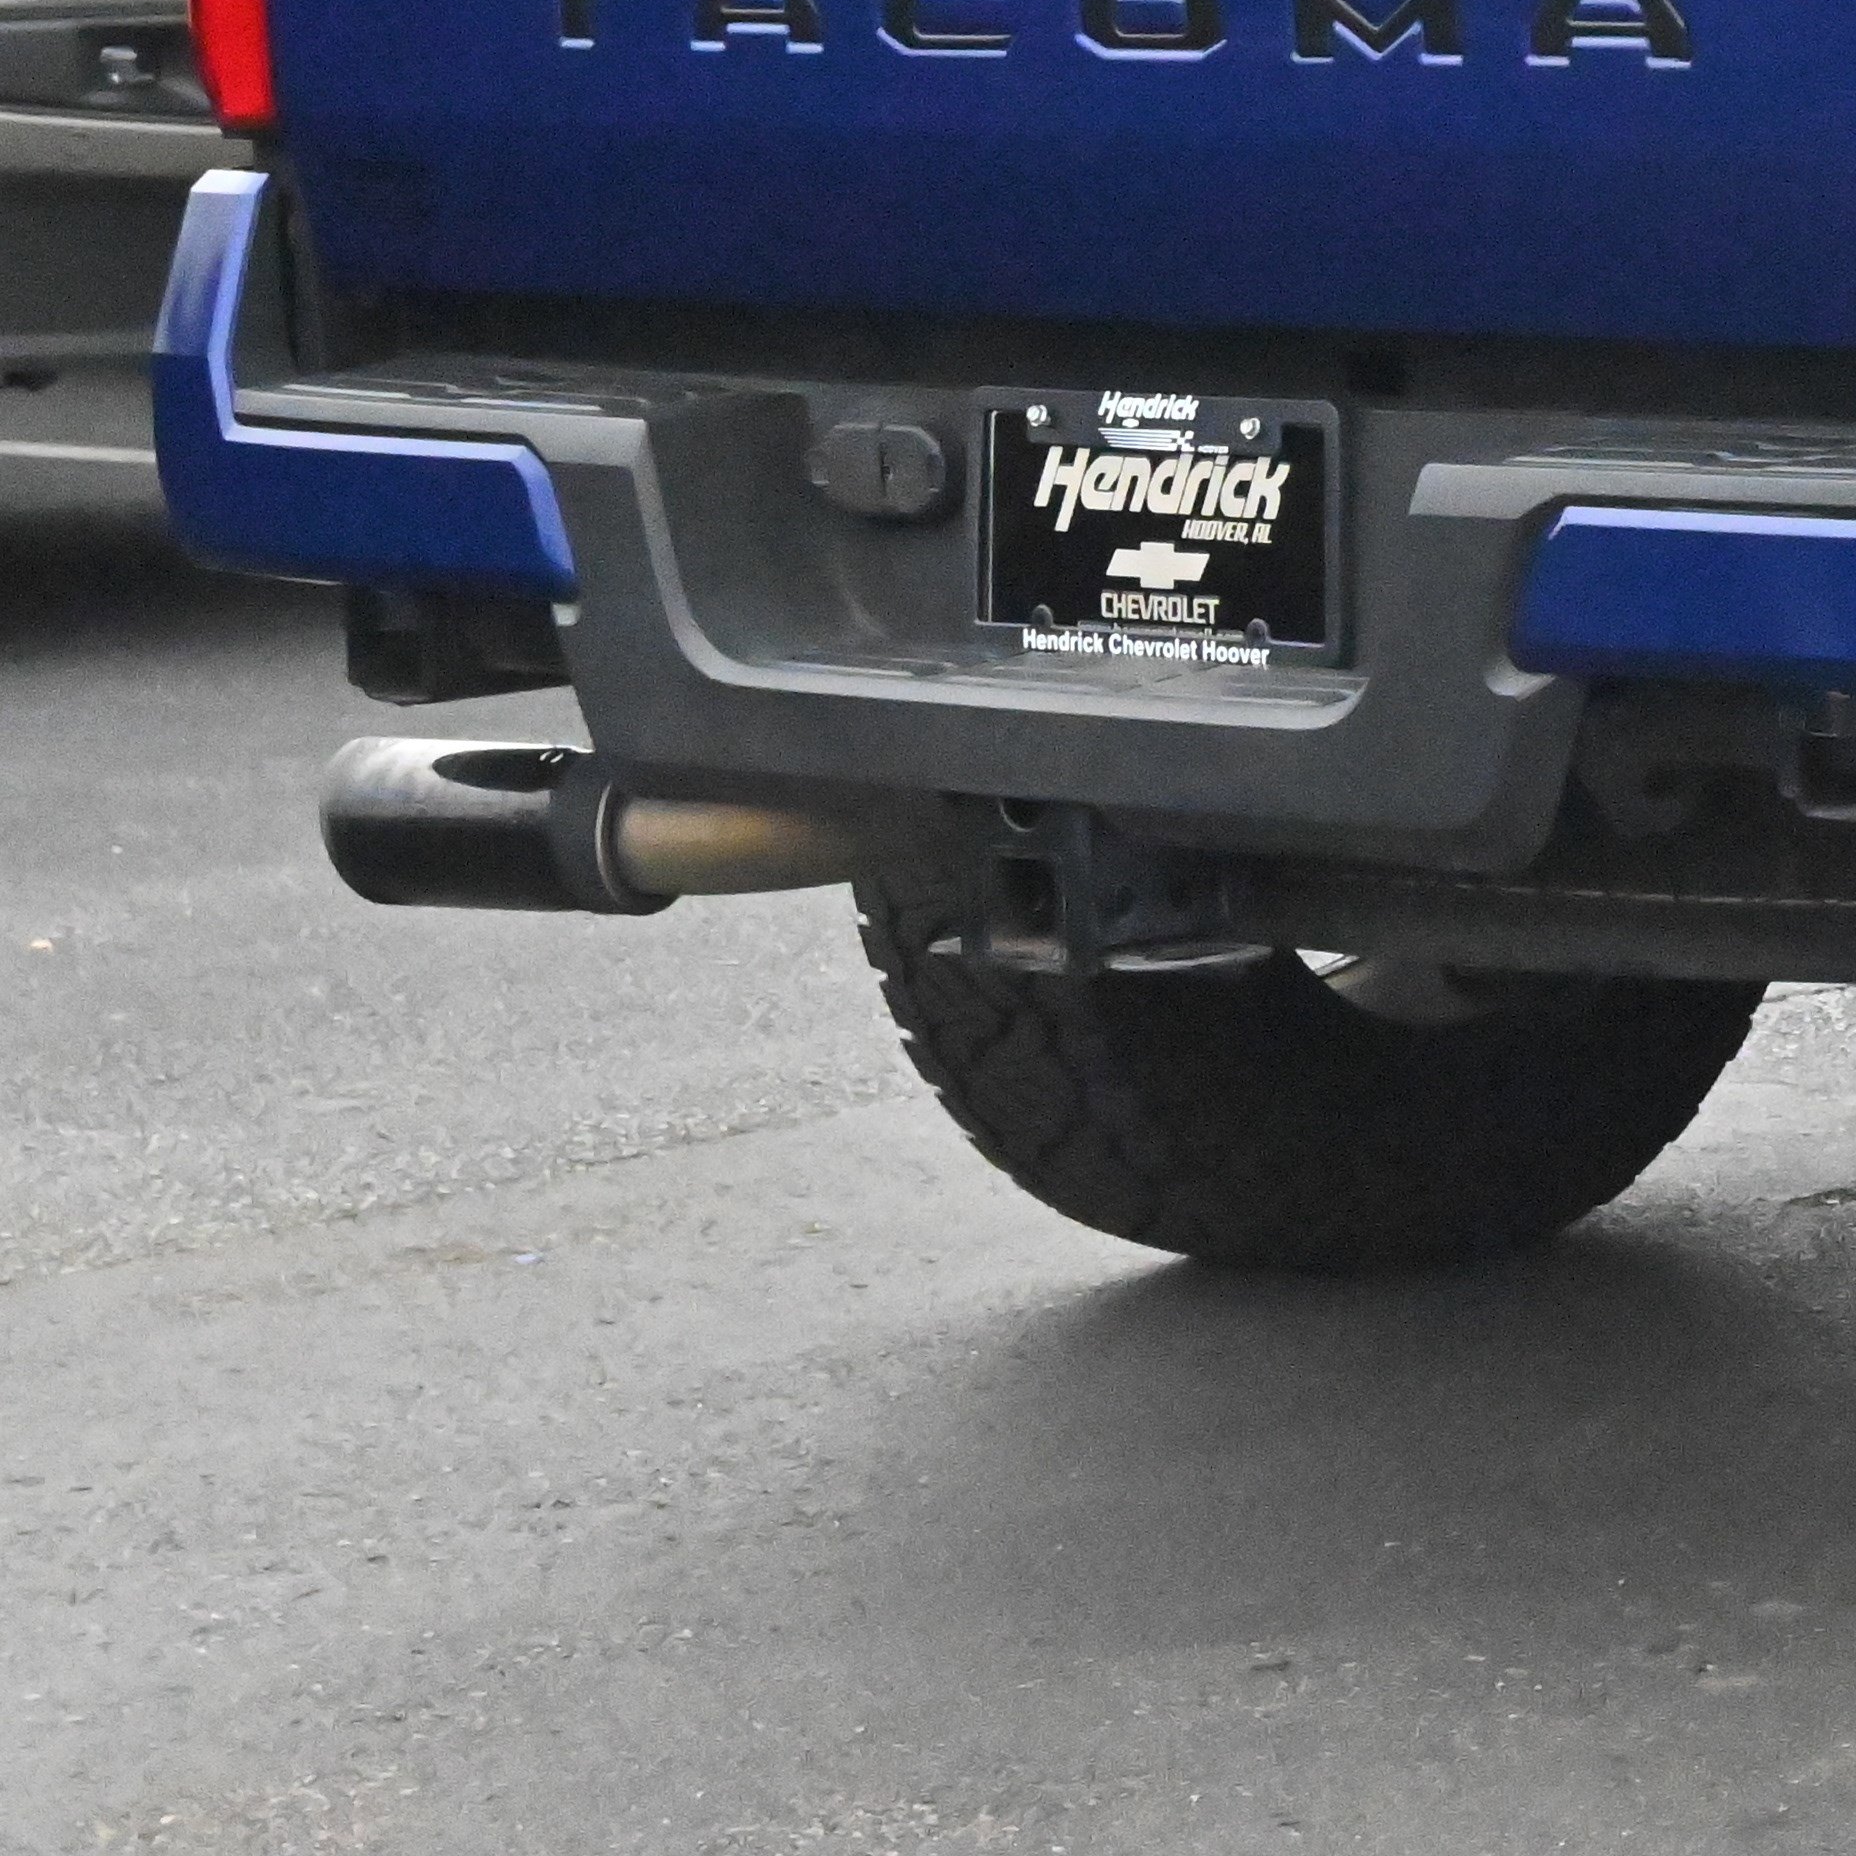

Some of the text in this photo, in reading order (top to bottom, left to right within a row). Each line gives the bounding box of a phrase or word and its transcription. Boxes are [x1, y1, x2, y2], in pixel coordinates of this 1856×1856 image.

[1098, 390, 1199, 423] Hendrick
[1034, 446, 1290, 532] Hendrick
[1101, 592, 1220, 625] CHEVROLET
[1023, 628, 1104, 654] Hendrick
[1109, 633, 1198, 661] Chevrolet
[1203, 640, 1270, 665] Hoover
